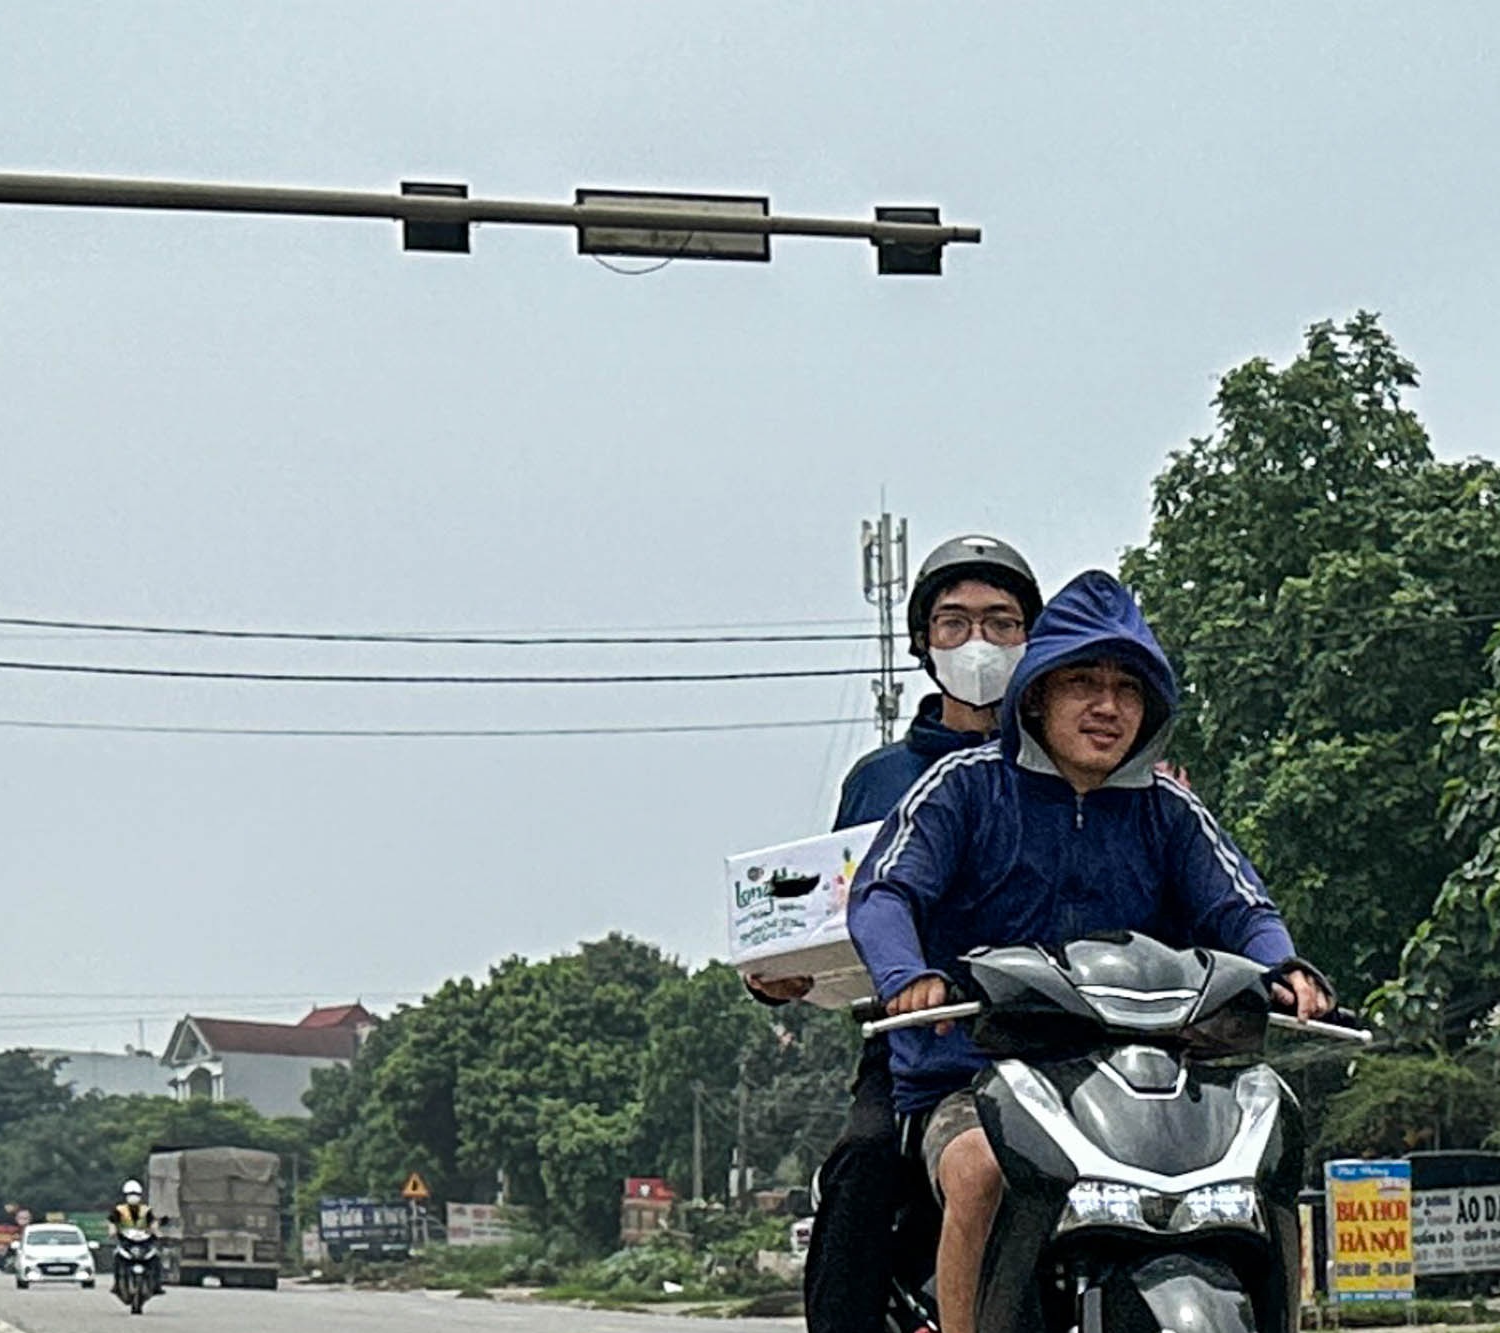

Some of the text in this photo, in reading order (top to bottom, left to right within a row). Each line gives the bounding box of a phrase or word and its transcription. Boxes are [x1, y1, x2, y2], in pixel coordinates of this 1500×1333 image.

[1336, 1200, 1370, 1222] BIA
[1338, 1226, 1368, 1253] HÀ
[1369, 1226, 1407, 1258] NỘI
